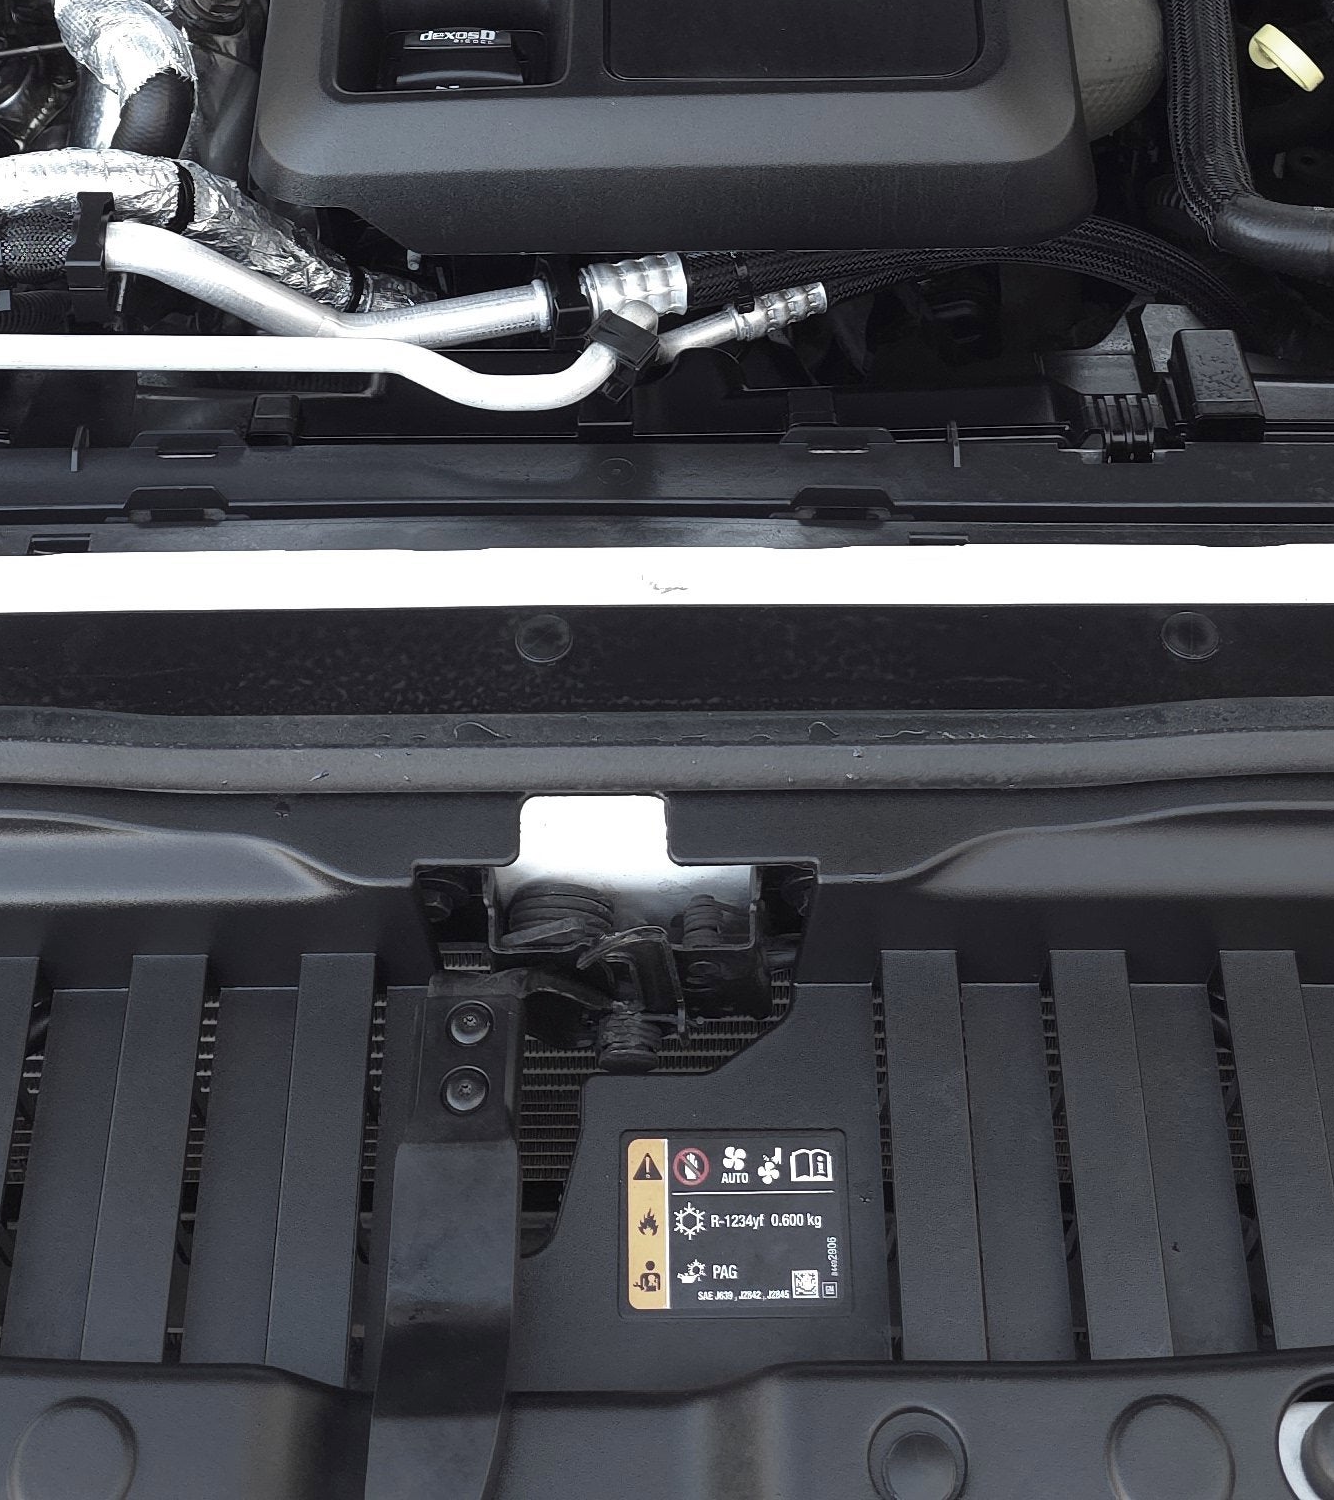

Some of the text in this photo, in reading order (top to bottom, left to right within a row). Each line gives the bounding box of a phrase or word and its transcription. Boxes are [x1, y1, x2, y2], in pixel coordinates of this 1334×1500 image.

[721, 1172, 749, 1184] AUTO
[710, 1213, 822, 1229] R-1234yf 0.600 kg
[712, 1265, 738, 1279] PAG
[698, 1291, 714, 1300] SAE
